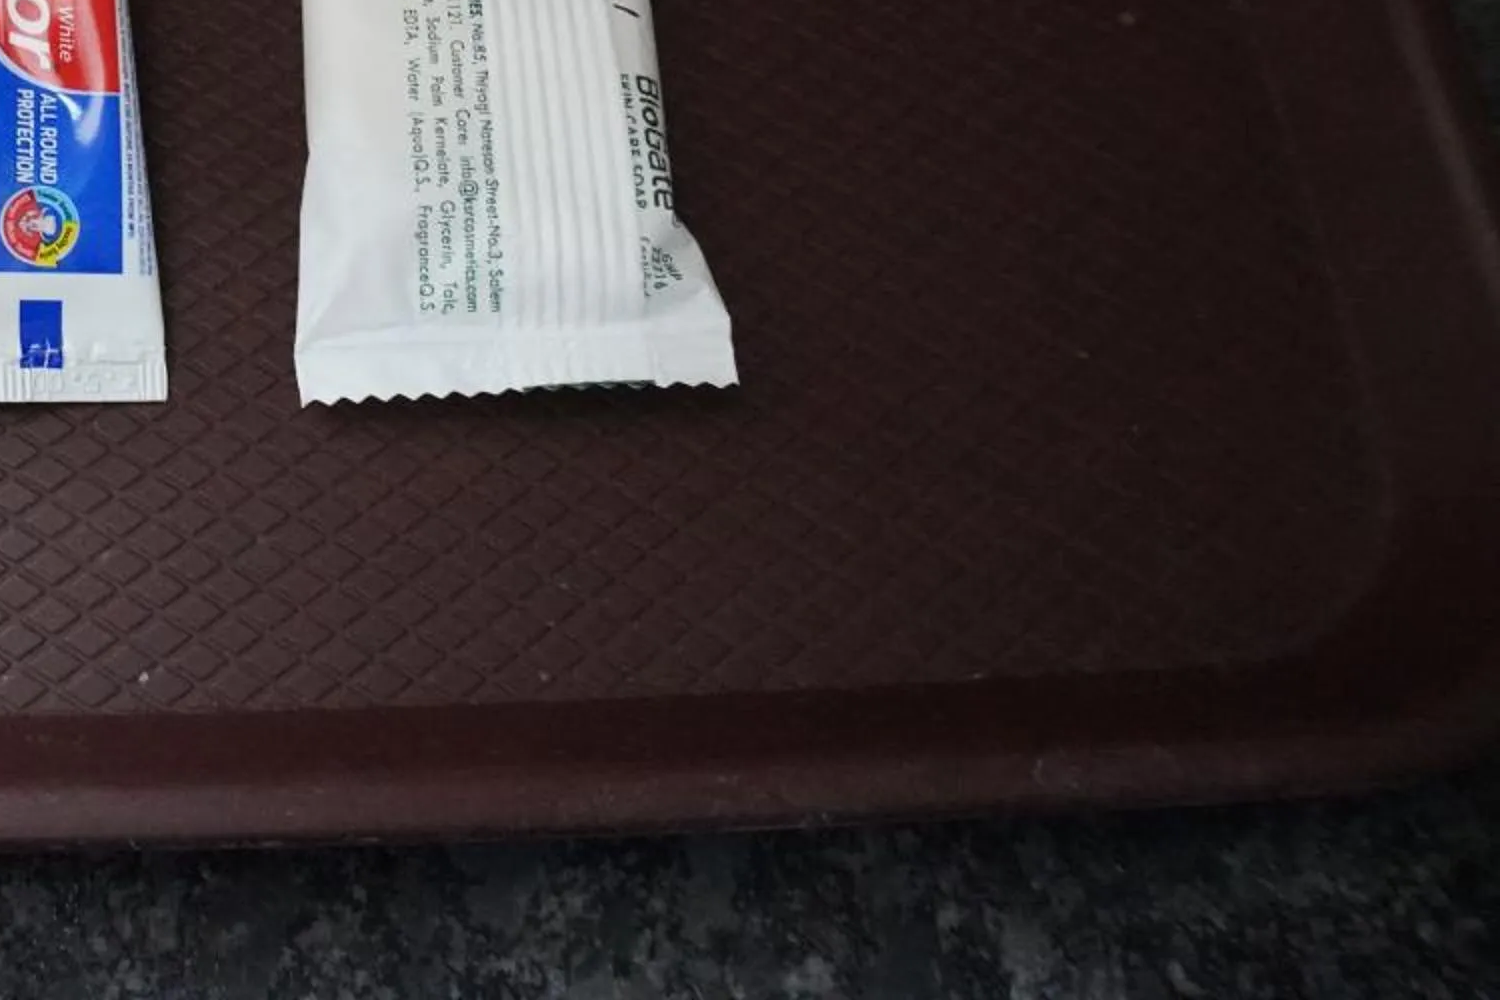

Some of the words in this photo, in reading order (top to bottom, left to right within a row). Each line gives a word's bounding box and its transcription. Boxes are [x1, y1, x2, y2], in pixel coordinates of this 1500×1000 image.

[57, 6, 76, 63] White
[426, 16, 443, 65] Sodium
[406, 57, 422, 102] Water
[430, 75, 447, 107] Palm
[449, 40, 467, 99] Customer
[39, 93, 57, 122] ALL
[16, 89, 35, 183] PROTECTION
[40, 128, 58, 184] ROUND
[488, 269, 504, 313] Salem
